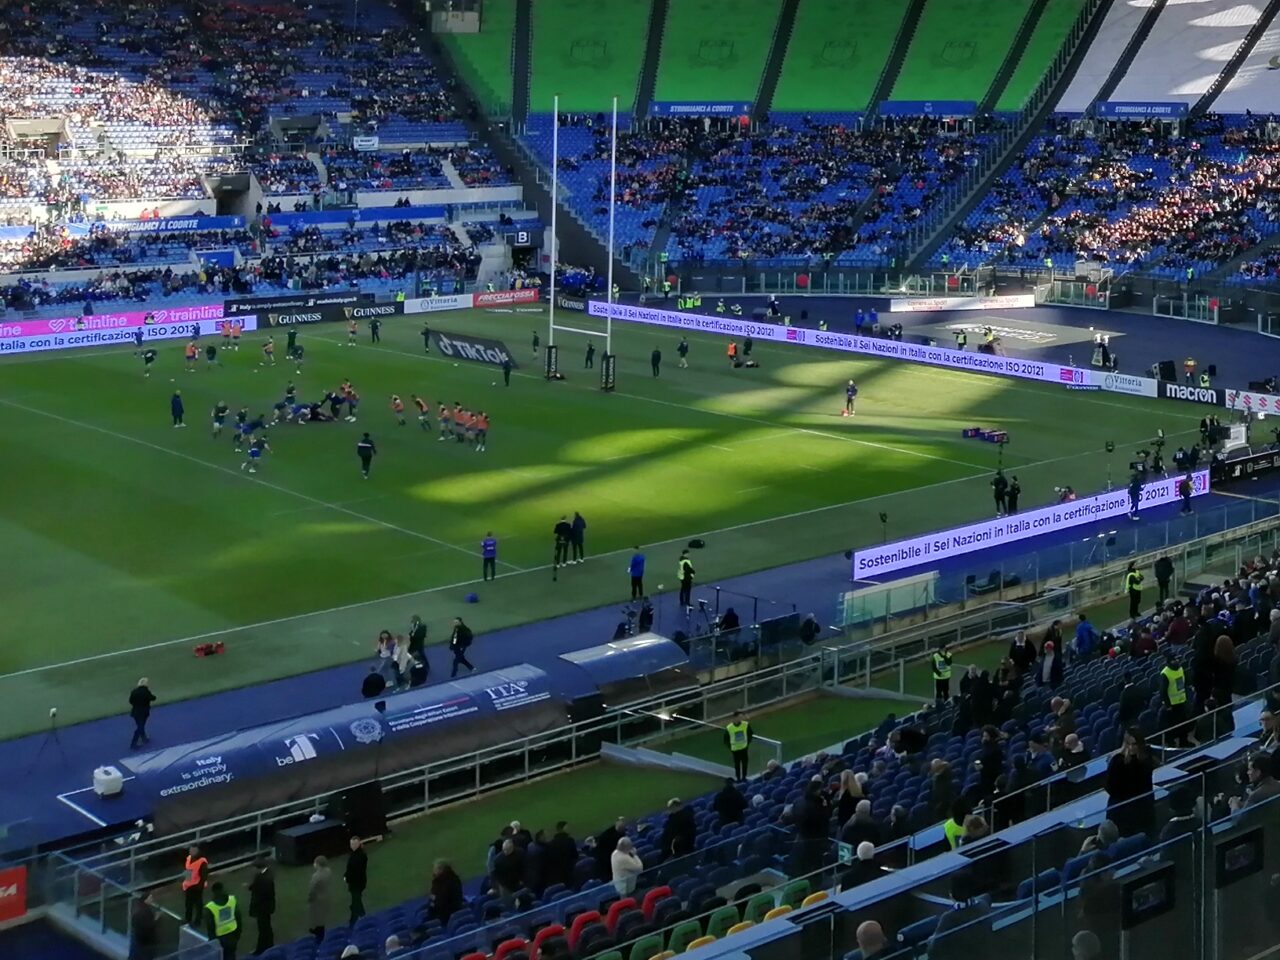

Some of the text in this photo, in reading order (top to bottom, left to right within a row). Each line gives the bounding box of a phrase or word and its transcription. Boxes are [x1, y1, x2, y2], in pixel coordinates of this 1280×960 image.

[518, 232, 528, 242] B
[170, 306, 224, 320] trainline
[354, 306, 395, 317] GUINNESS
[593, 304, 622, 316] Sosteibile
[69, 315, 128, 330] tainline
[279, 312, 322, 324] GUINNESS
[30, 340, 50, 348] con
[54, 337, 64, 346] la
[73, 330, 139, 344] certificazion
[148, 326, 167, 336] ISO
[451, 340, 509, 365] TikTok
[815, 334, 852, 348] Sostenibile
[860, 340, 871, 350] Sei
[872, 342, 899, 354] Nazioni
[900, 345, 907, 355] in
[908, 346, 926, 358] Italia
[928, 351, 942, 360] con
[944, 352, 950, 362] la
[952, 354, 1004, 370] certificazione
[1006, 361, 1020, 372] ISO
[1022, 363, 1044, 376] 20121
[1114, 374, 1143, 387] Vittoria
[1166, 383, 1217, 404] macron
[859, 486, 1170, 570] Sostenibile il Sei Nazioni in Italia con la certificazione IO 20121
[196, 755, 222, 767] Italy
[181, 763, 228, 780] is simply
